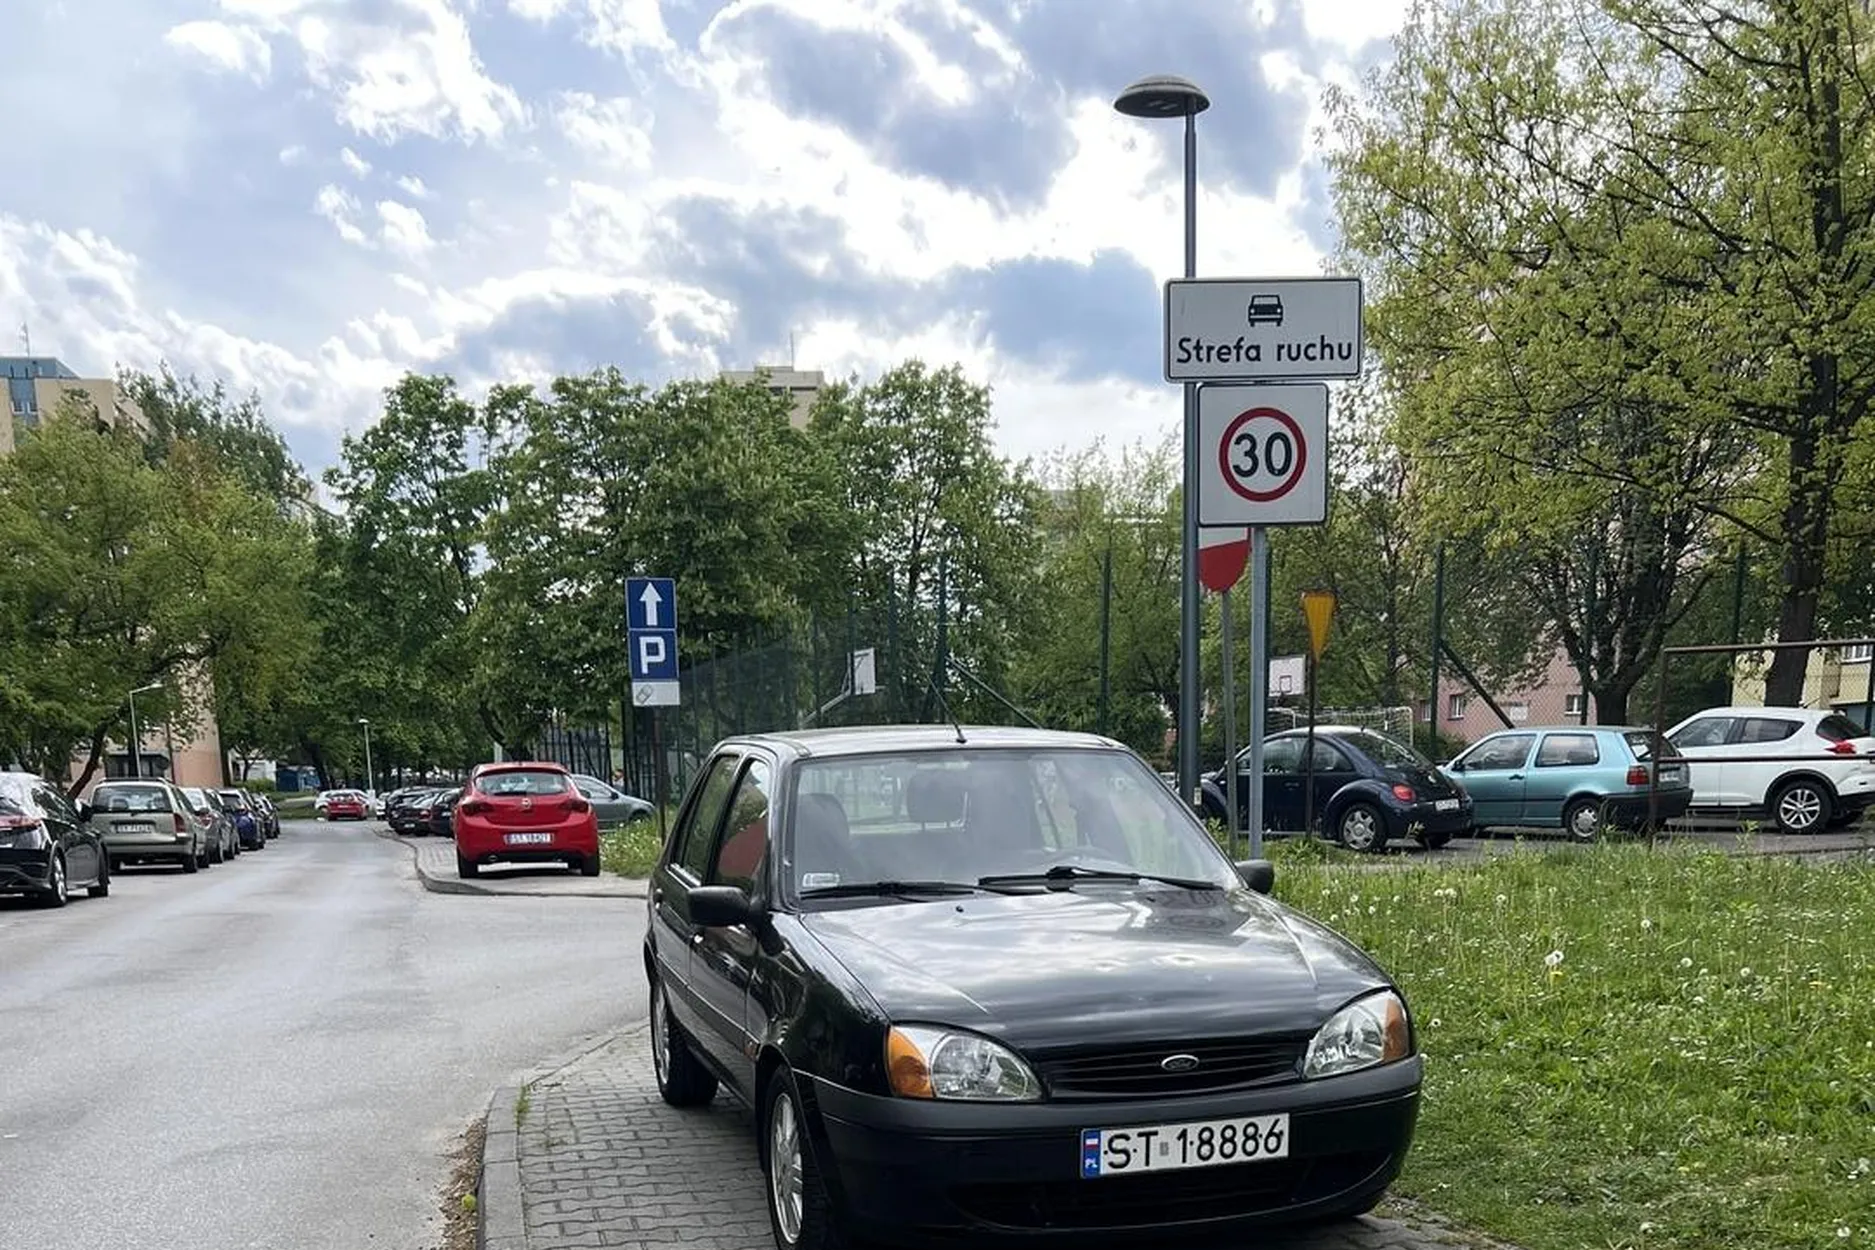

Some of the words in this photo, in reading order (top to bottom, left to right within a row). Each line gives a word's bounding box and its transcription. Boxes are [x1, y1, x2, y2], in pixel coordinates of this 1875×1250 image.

[1176, 336, 1262, 363] Strefa
[1276, 335, 1353, 362] ruchu
[1232, 431, 1293, 478] 30
[638, 635, 667, 675] P
[1107, 1129, 1159, 1169] ST
[1176, 1118, 1283, 1164] 18886
